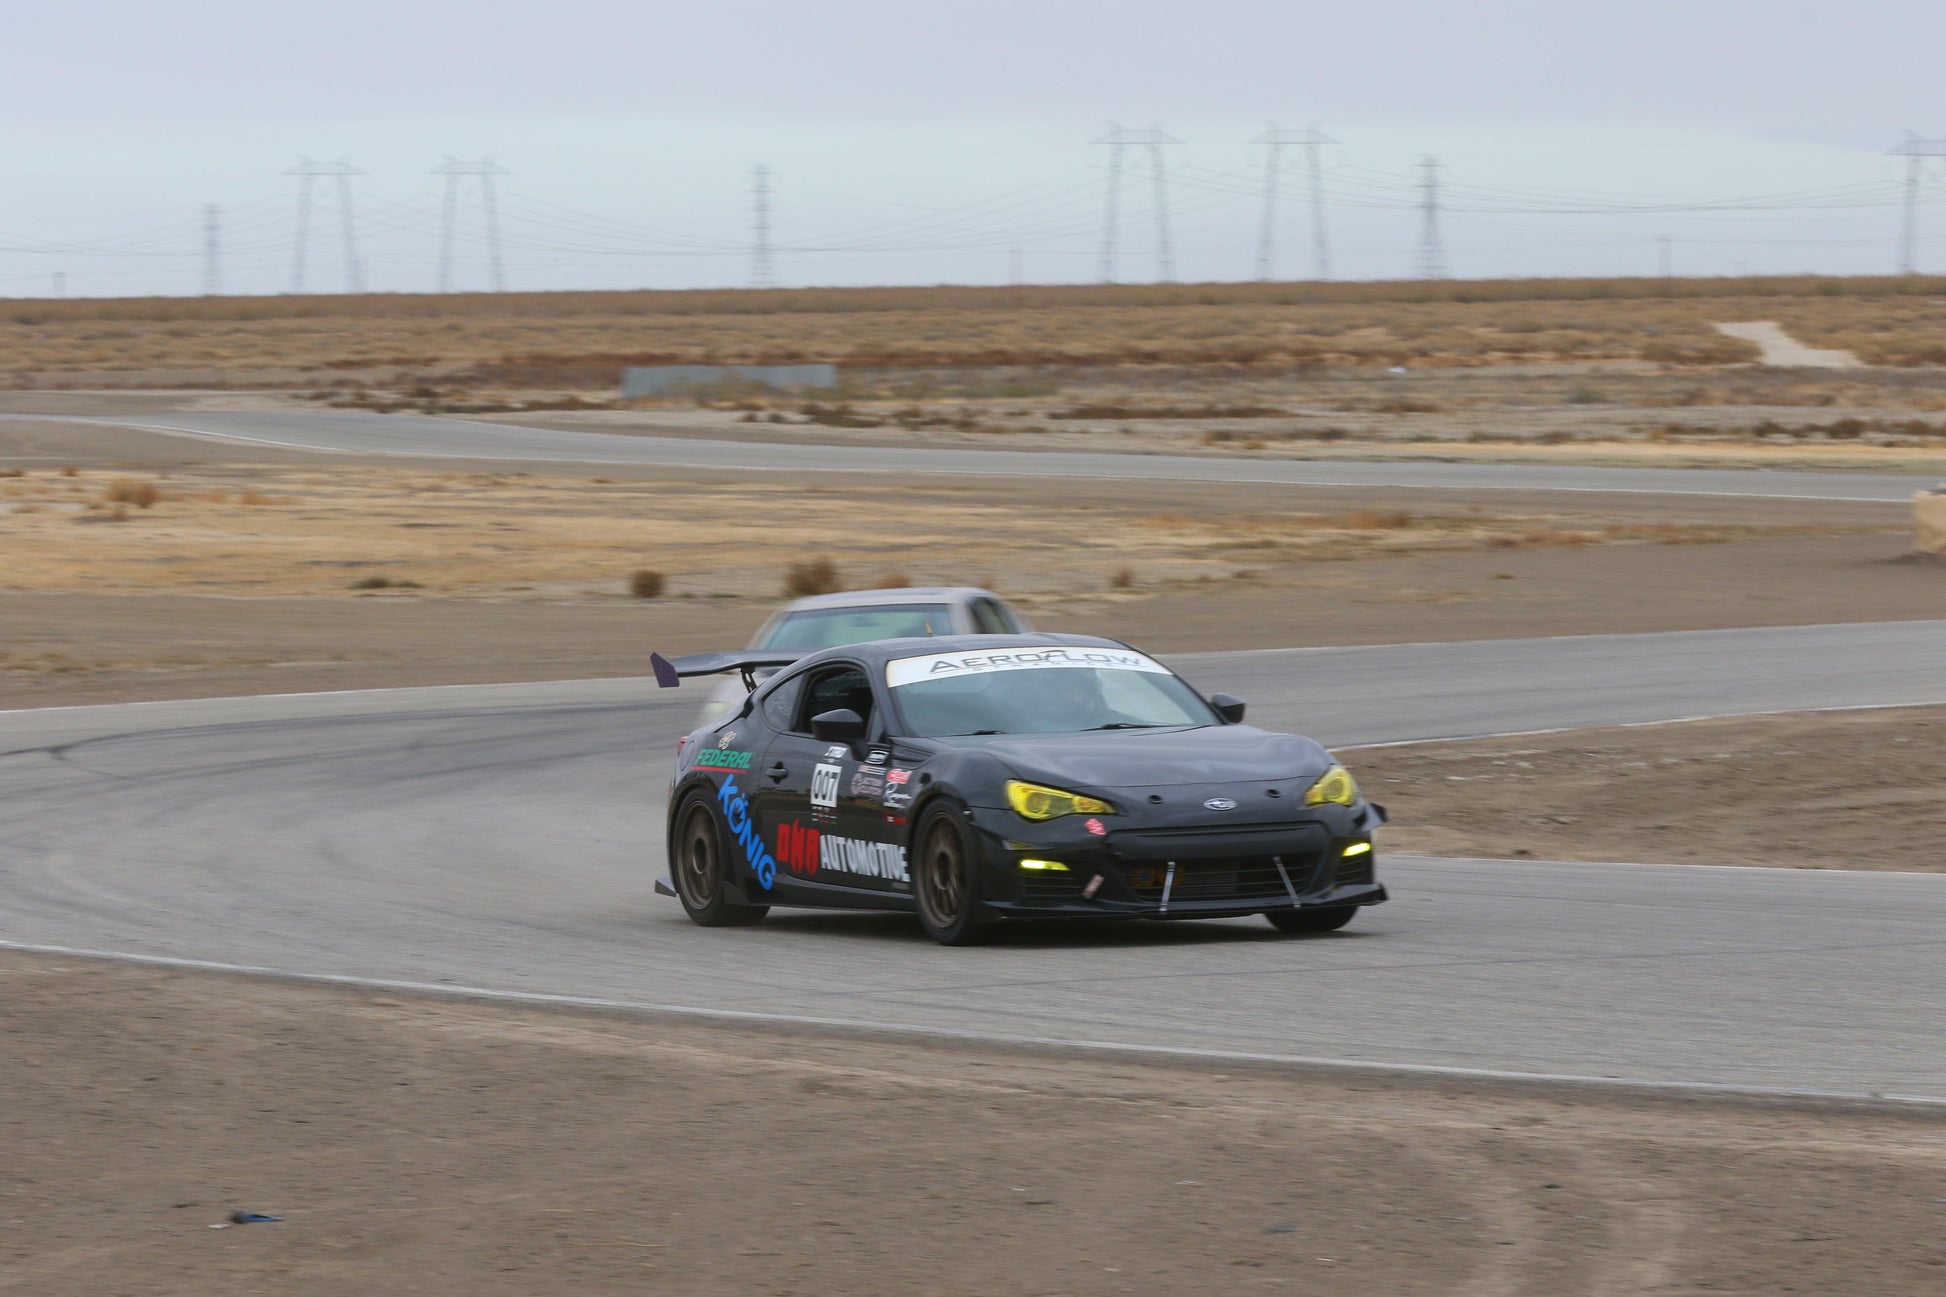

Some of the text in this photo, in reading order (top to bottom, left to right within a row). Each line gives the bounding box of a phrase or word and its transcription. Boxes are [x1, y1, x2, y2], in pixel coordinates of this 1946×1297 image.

[929, 650, 1141, 673] AEROFLOW
[694, 749, 753, 769] FEDERAL
[813, 769, 839, 801] 007
[717, 774, 777, 890] KÖNIG
[820, 834, 911, 883] AUTOMOTIVE
